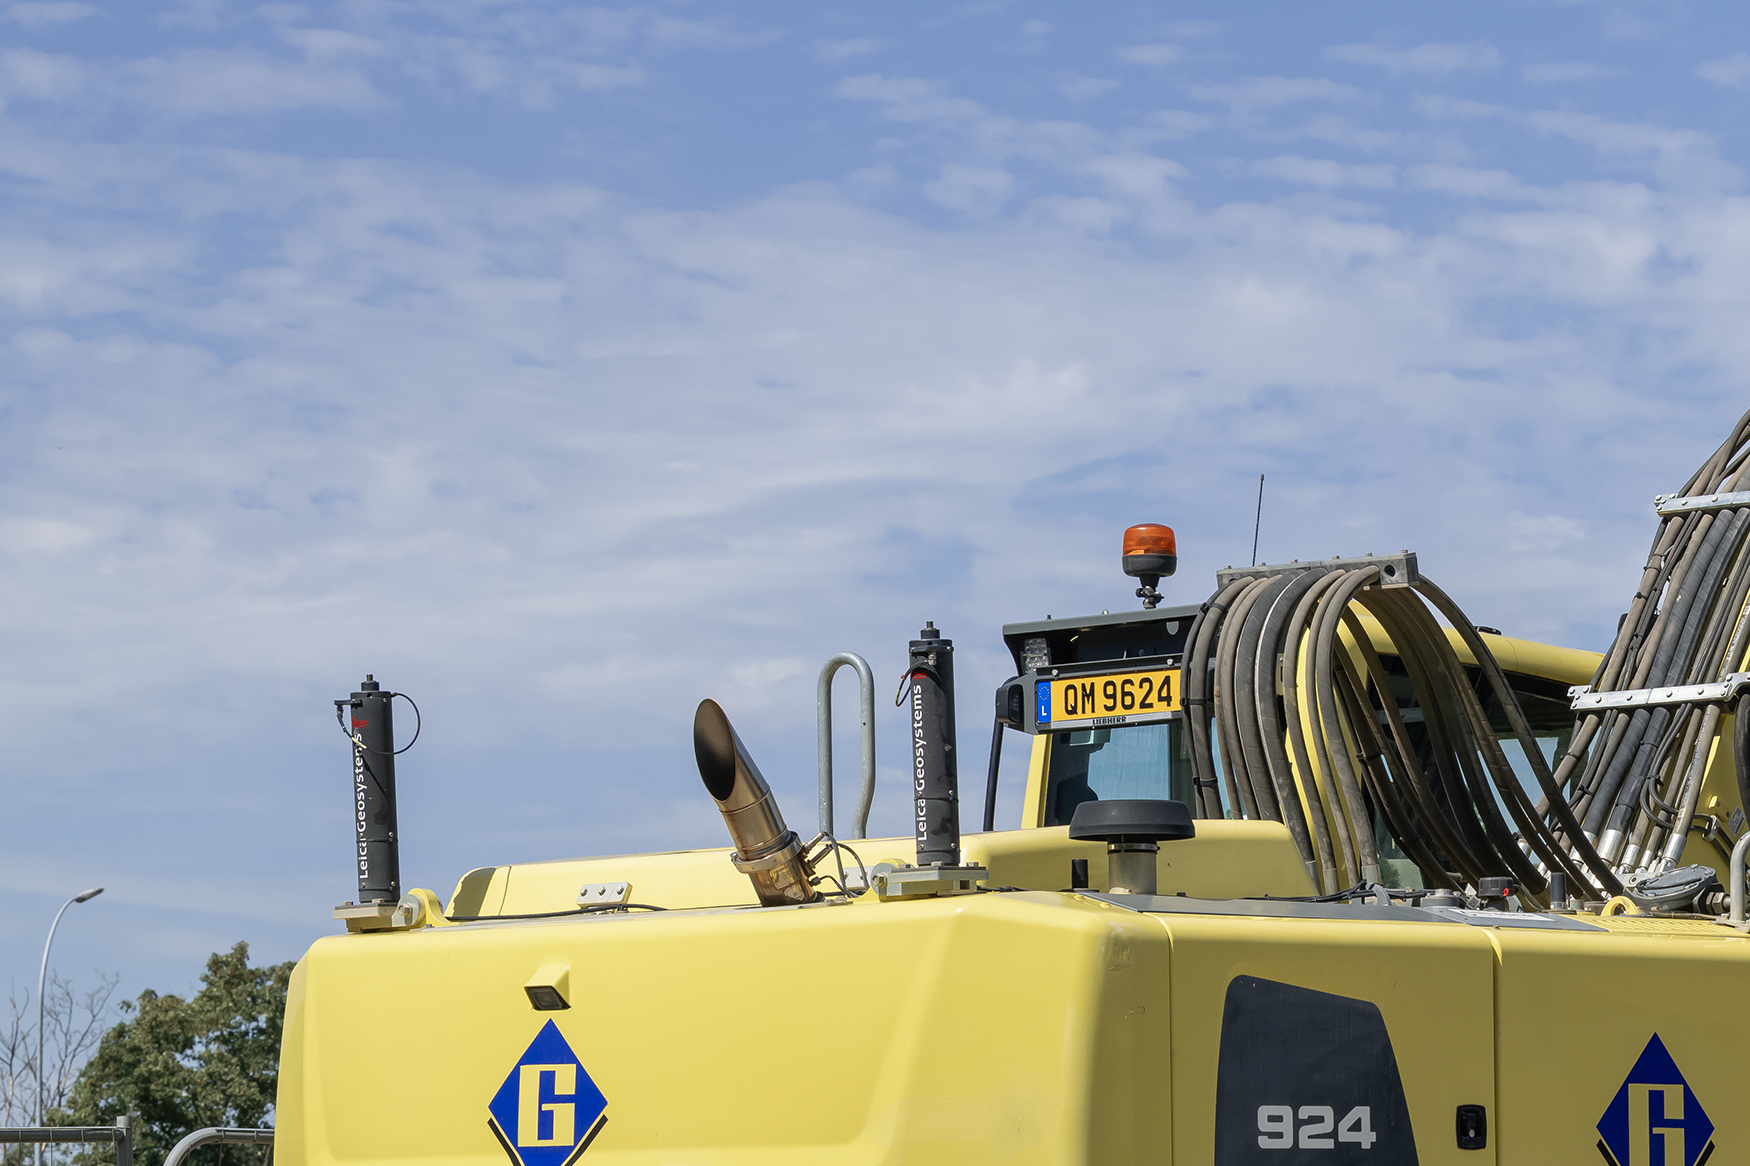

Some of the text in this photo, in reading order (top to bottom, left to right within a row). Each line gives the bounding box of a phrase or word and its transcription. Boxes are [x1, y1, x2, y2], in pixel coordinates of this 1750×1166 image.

[1041, 675, 1173, 717] L QM 9624
[912, 684, 927, 791] Geosystems
[1092, 716, 1127, 726] LIEBHERR
[916, 798, 928, 842] Leica
[358, 837, 369, 879] Leica
[518, 1063, 577, 1148] G
[1256, 1105, 1378, 1150] 924
